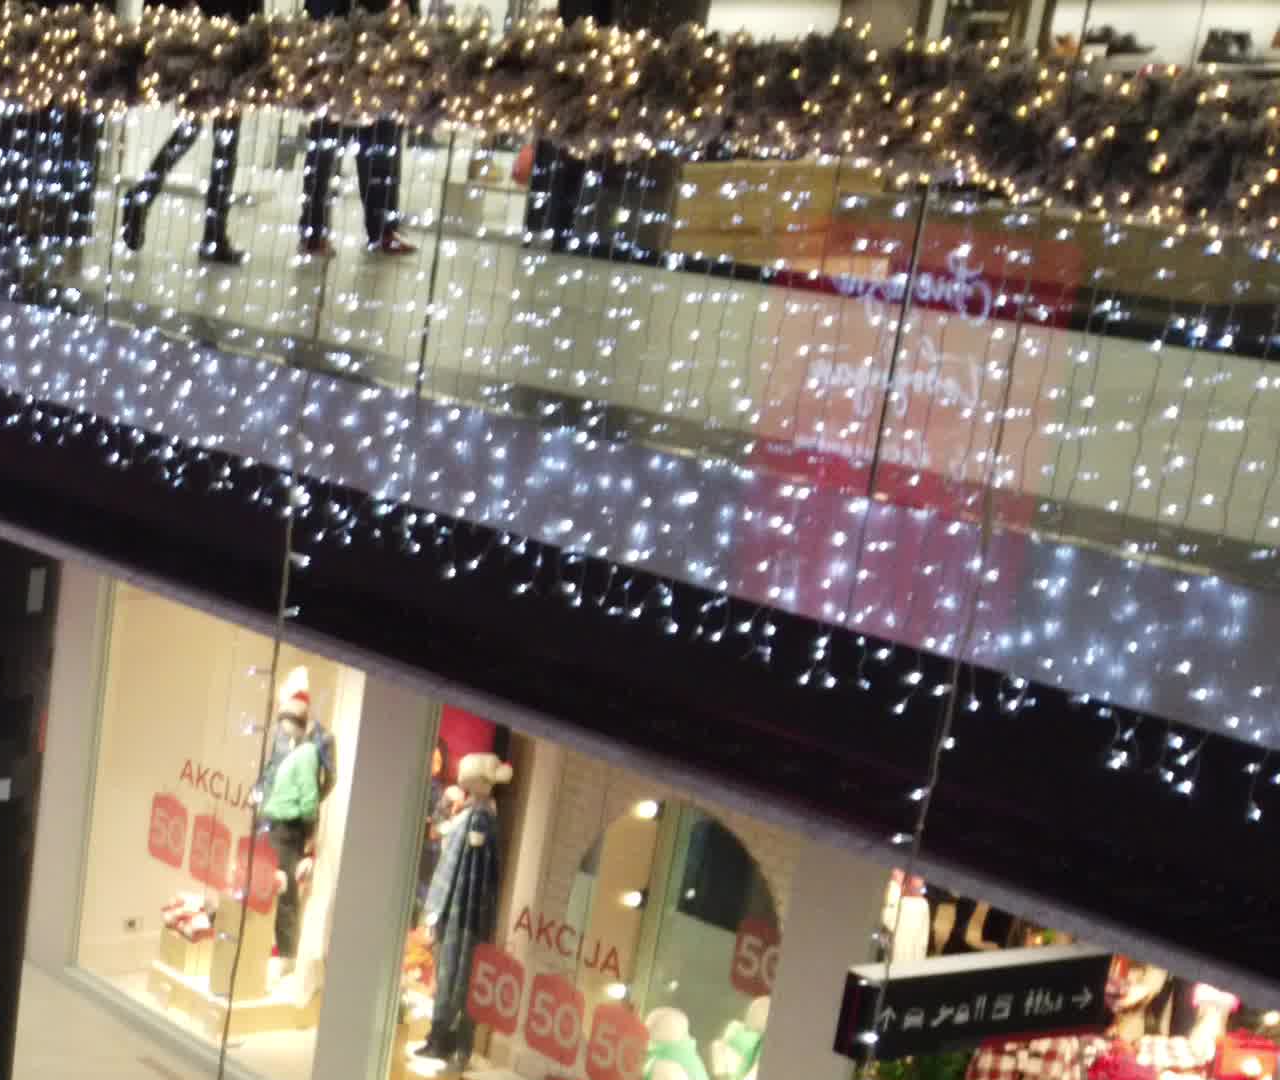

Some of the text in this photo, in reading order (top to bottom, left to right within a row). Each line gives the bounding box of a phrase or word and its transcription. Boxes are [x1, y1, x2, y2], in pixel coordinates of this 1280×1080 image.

[513, 906, 621, 978] AKCIJA
[471, 960, 521, 1018] 50
[529, 992, 581, 1049] 50
